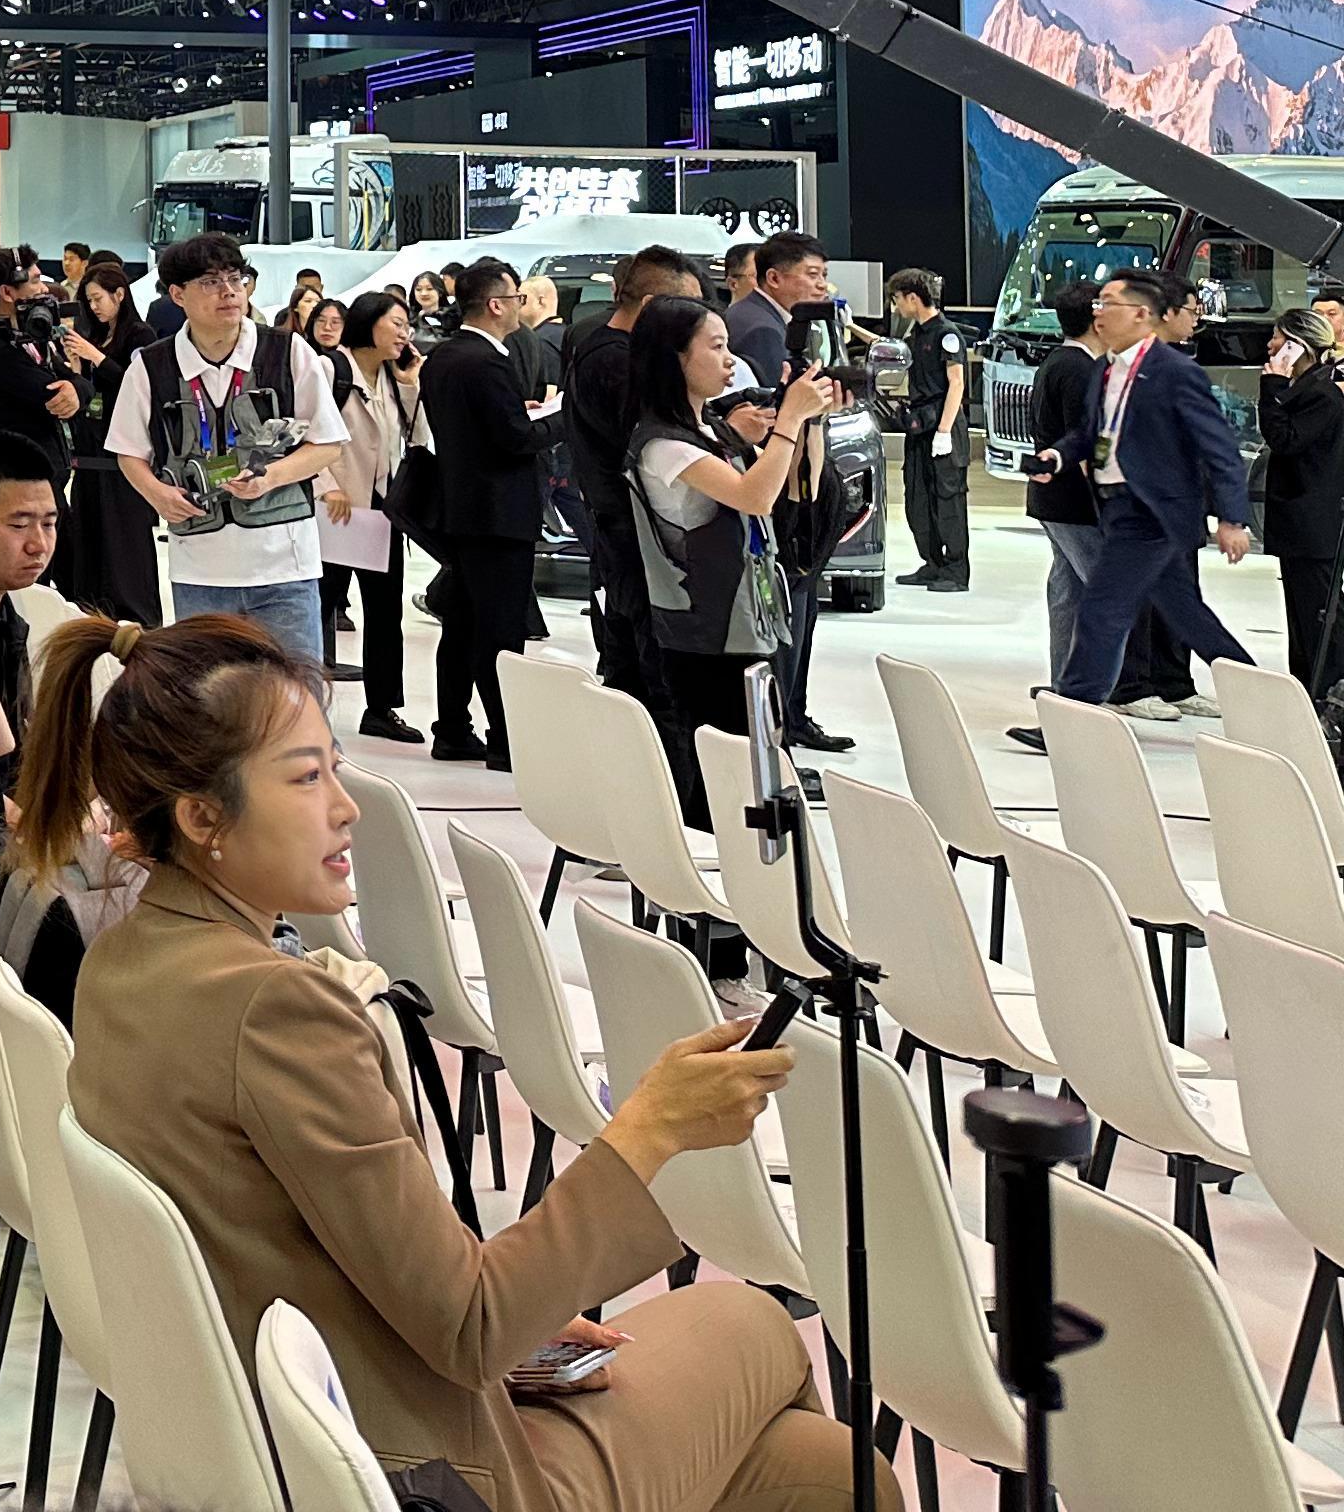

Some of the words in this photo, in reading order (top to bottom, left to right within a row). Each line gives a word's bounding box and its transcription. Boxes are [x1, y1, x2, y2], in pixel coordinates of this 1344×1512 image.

[714, 33, 822, 88] 智能一切移动
